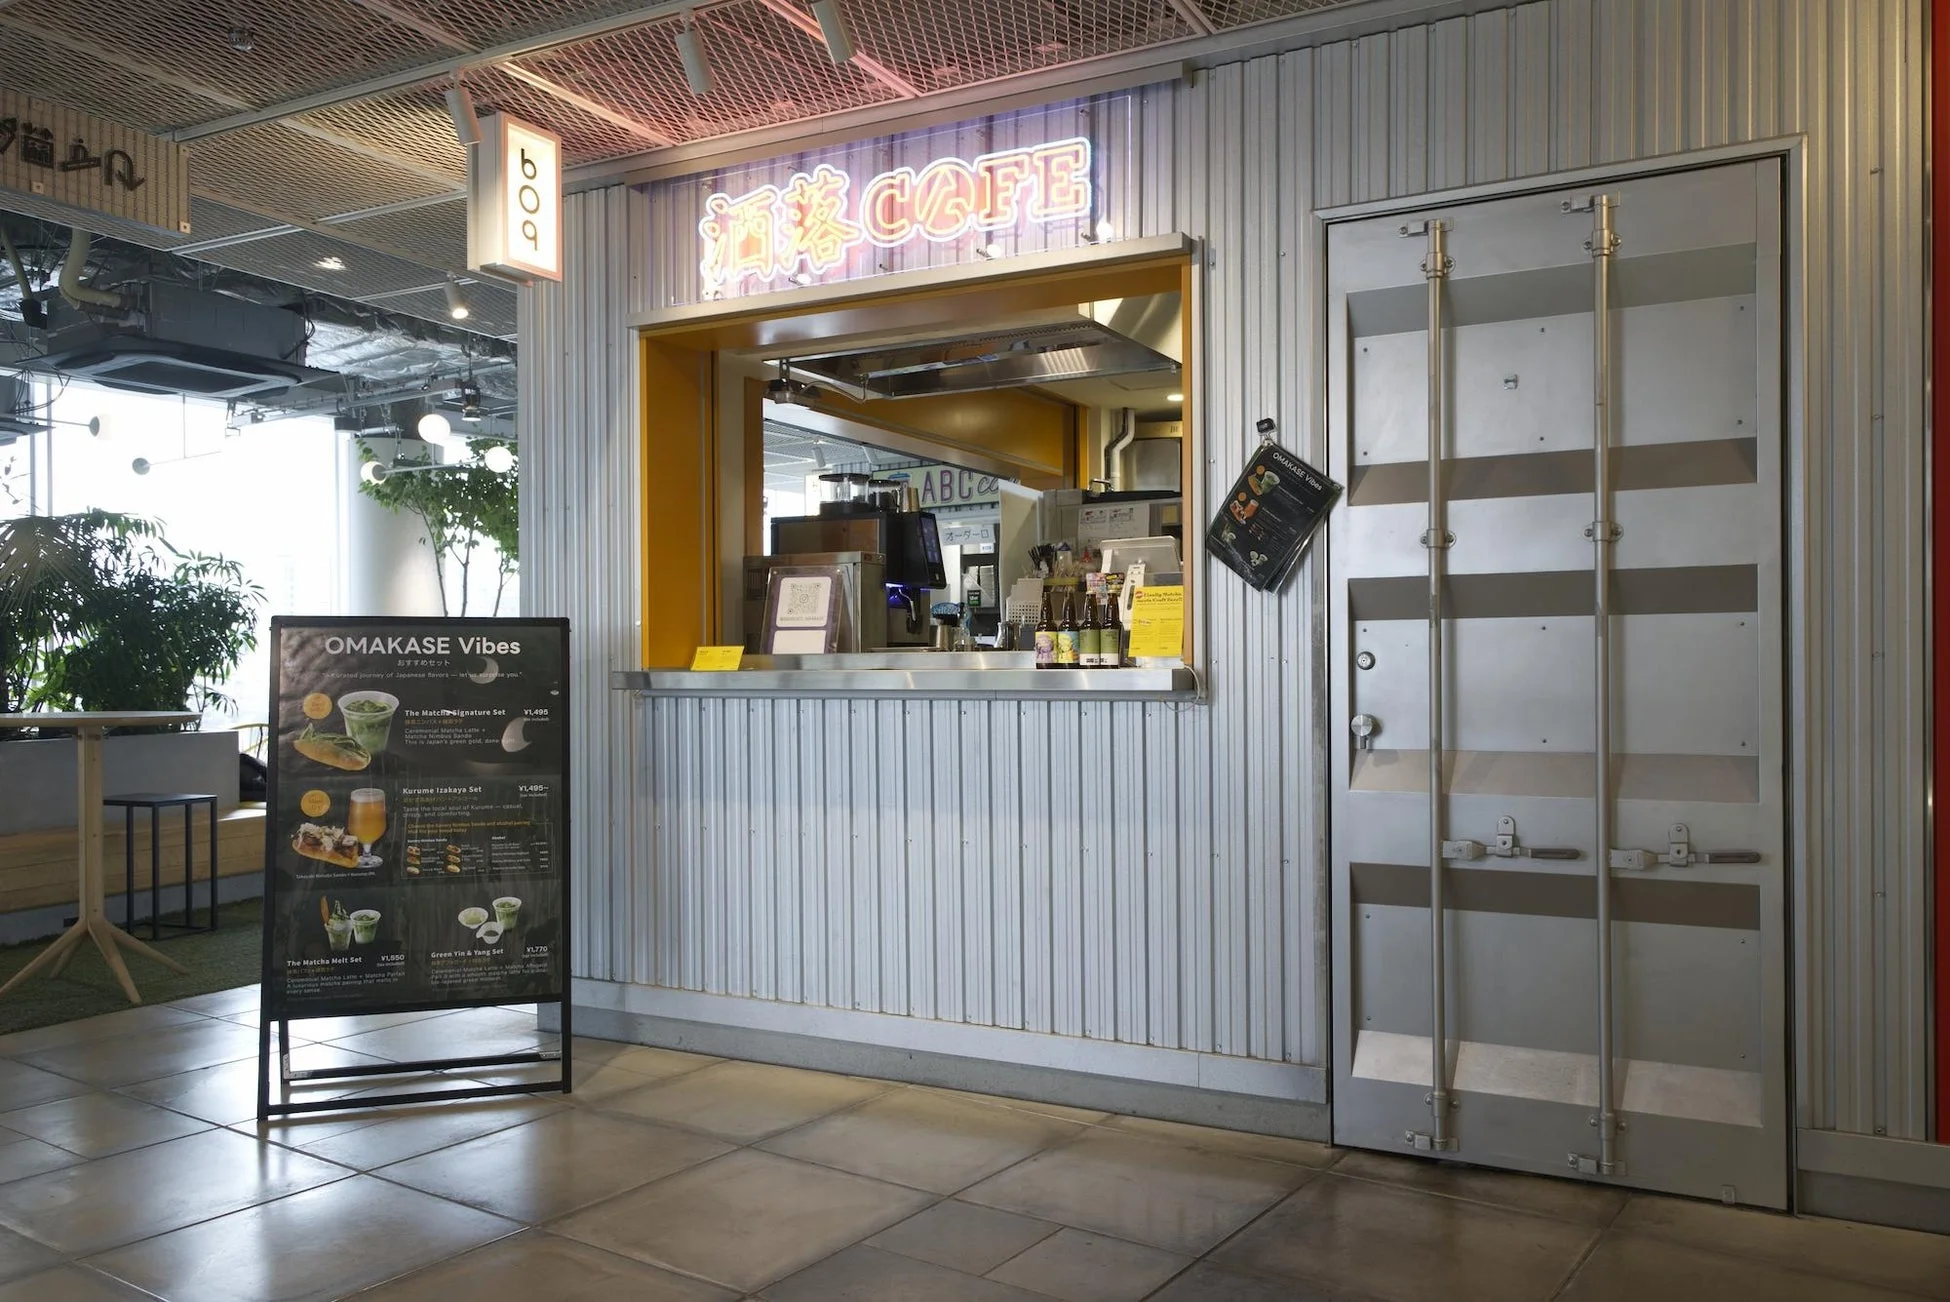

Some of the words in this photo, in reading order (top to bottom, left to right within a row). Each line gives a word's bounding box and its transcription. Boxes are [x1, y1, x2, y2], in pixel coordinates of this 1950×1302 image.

[863, 137, 1092, 248] CAFE
[1272, 452, 1306, 480] OMAKASE
[1304, 474, 1323, 492] Vibes
[921, 469, 974, 505] ABC
[325, 636, 451, 655] OMAKASE
[458, 636, 521, 655] Vibes
[396, 658, 450, 668] おすすめセット
[396, 672, 426, 680] Japanese
[452, 709, 491, 718] Signature
[523, 708, 549, 716] ¥1,495
[436, 786, 467, 795] Izakaya
[474, 950, 491, 958] Yang
[302, 958, 330, 966] Matcha
[350, 956, 362, 964] Set
